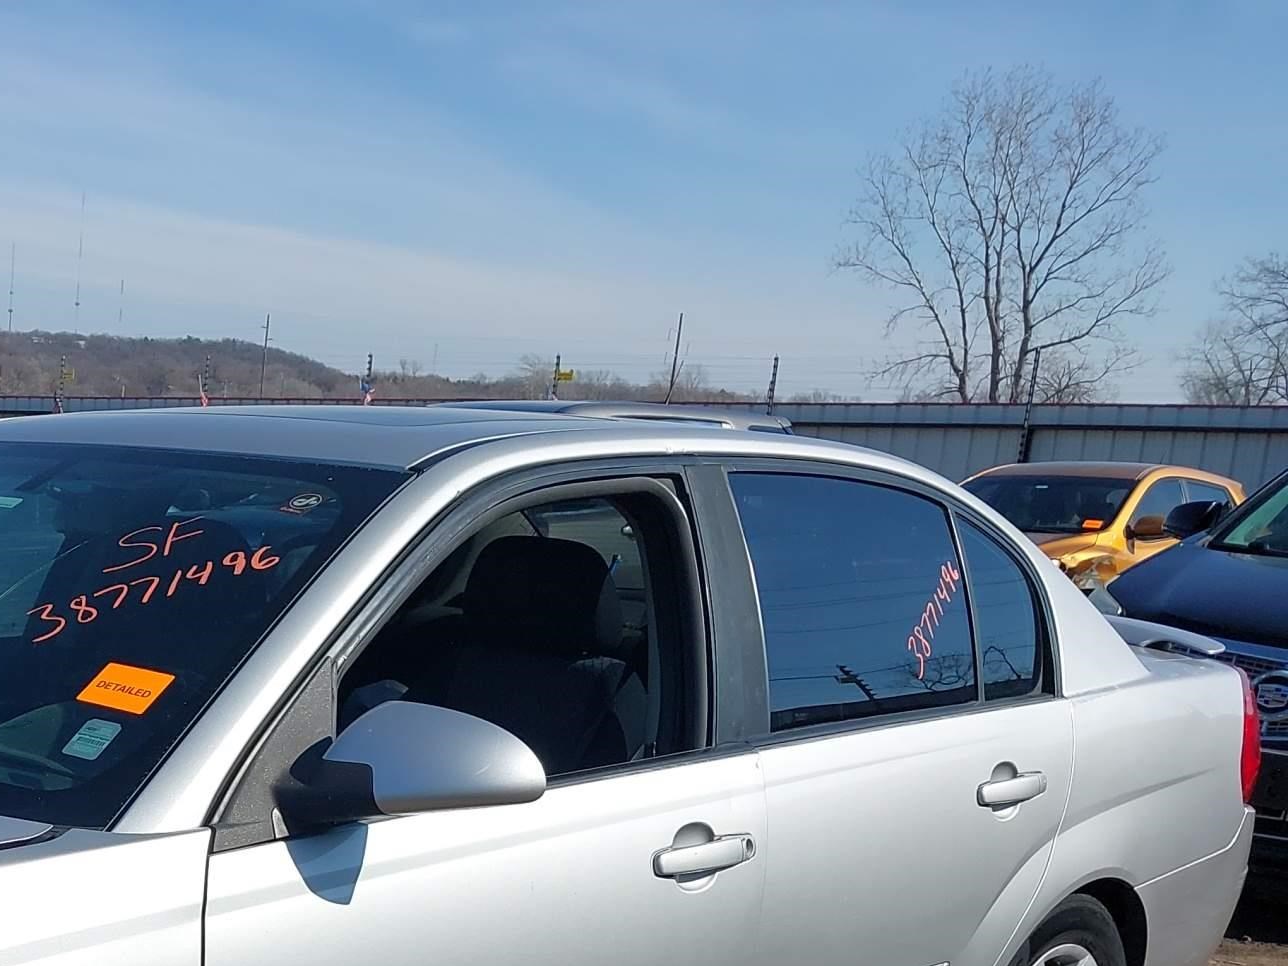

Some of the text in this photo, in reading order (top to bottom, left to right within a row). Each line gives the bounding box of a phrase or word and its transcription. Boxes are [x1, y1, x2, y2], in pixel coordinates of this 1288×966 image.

[102, 515, 206, 573] SF
[26, 546, 281, 643] 38771496
[907, 560, 959, 680] 38771496
[95, 680, 152, 698] DETAILED
